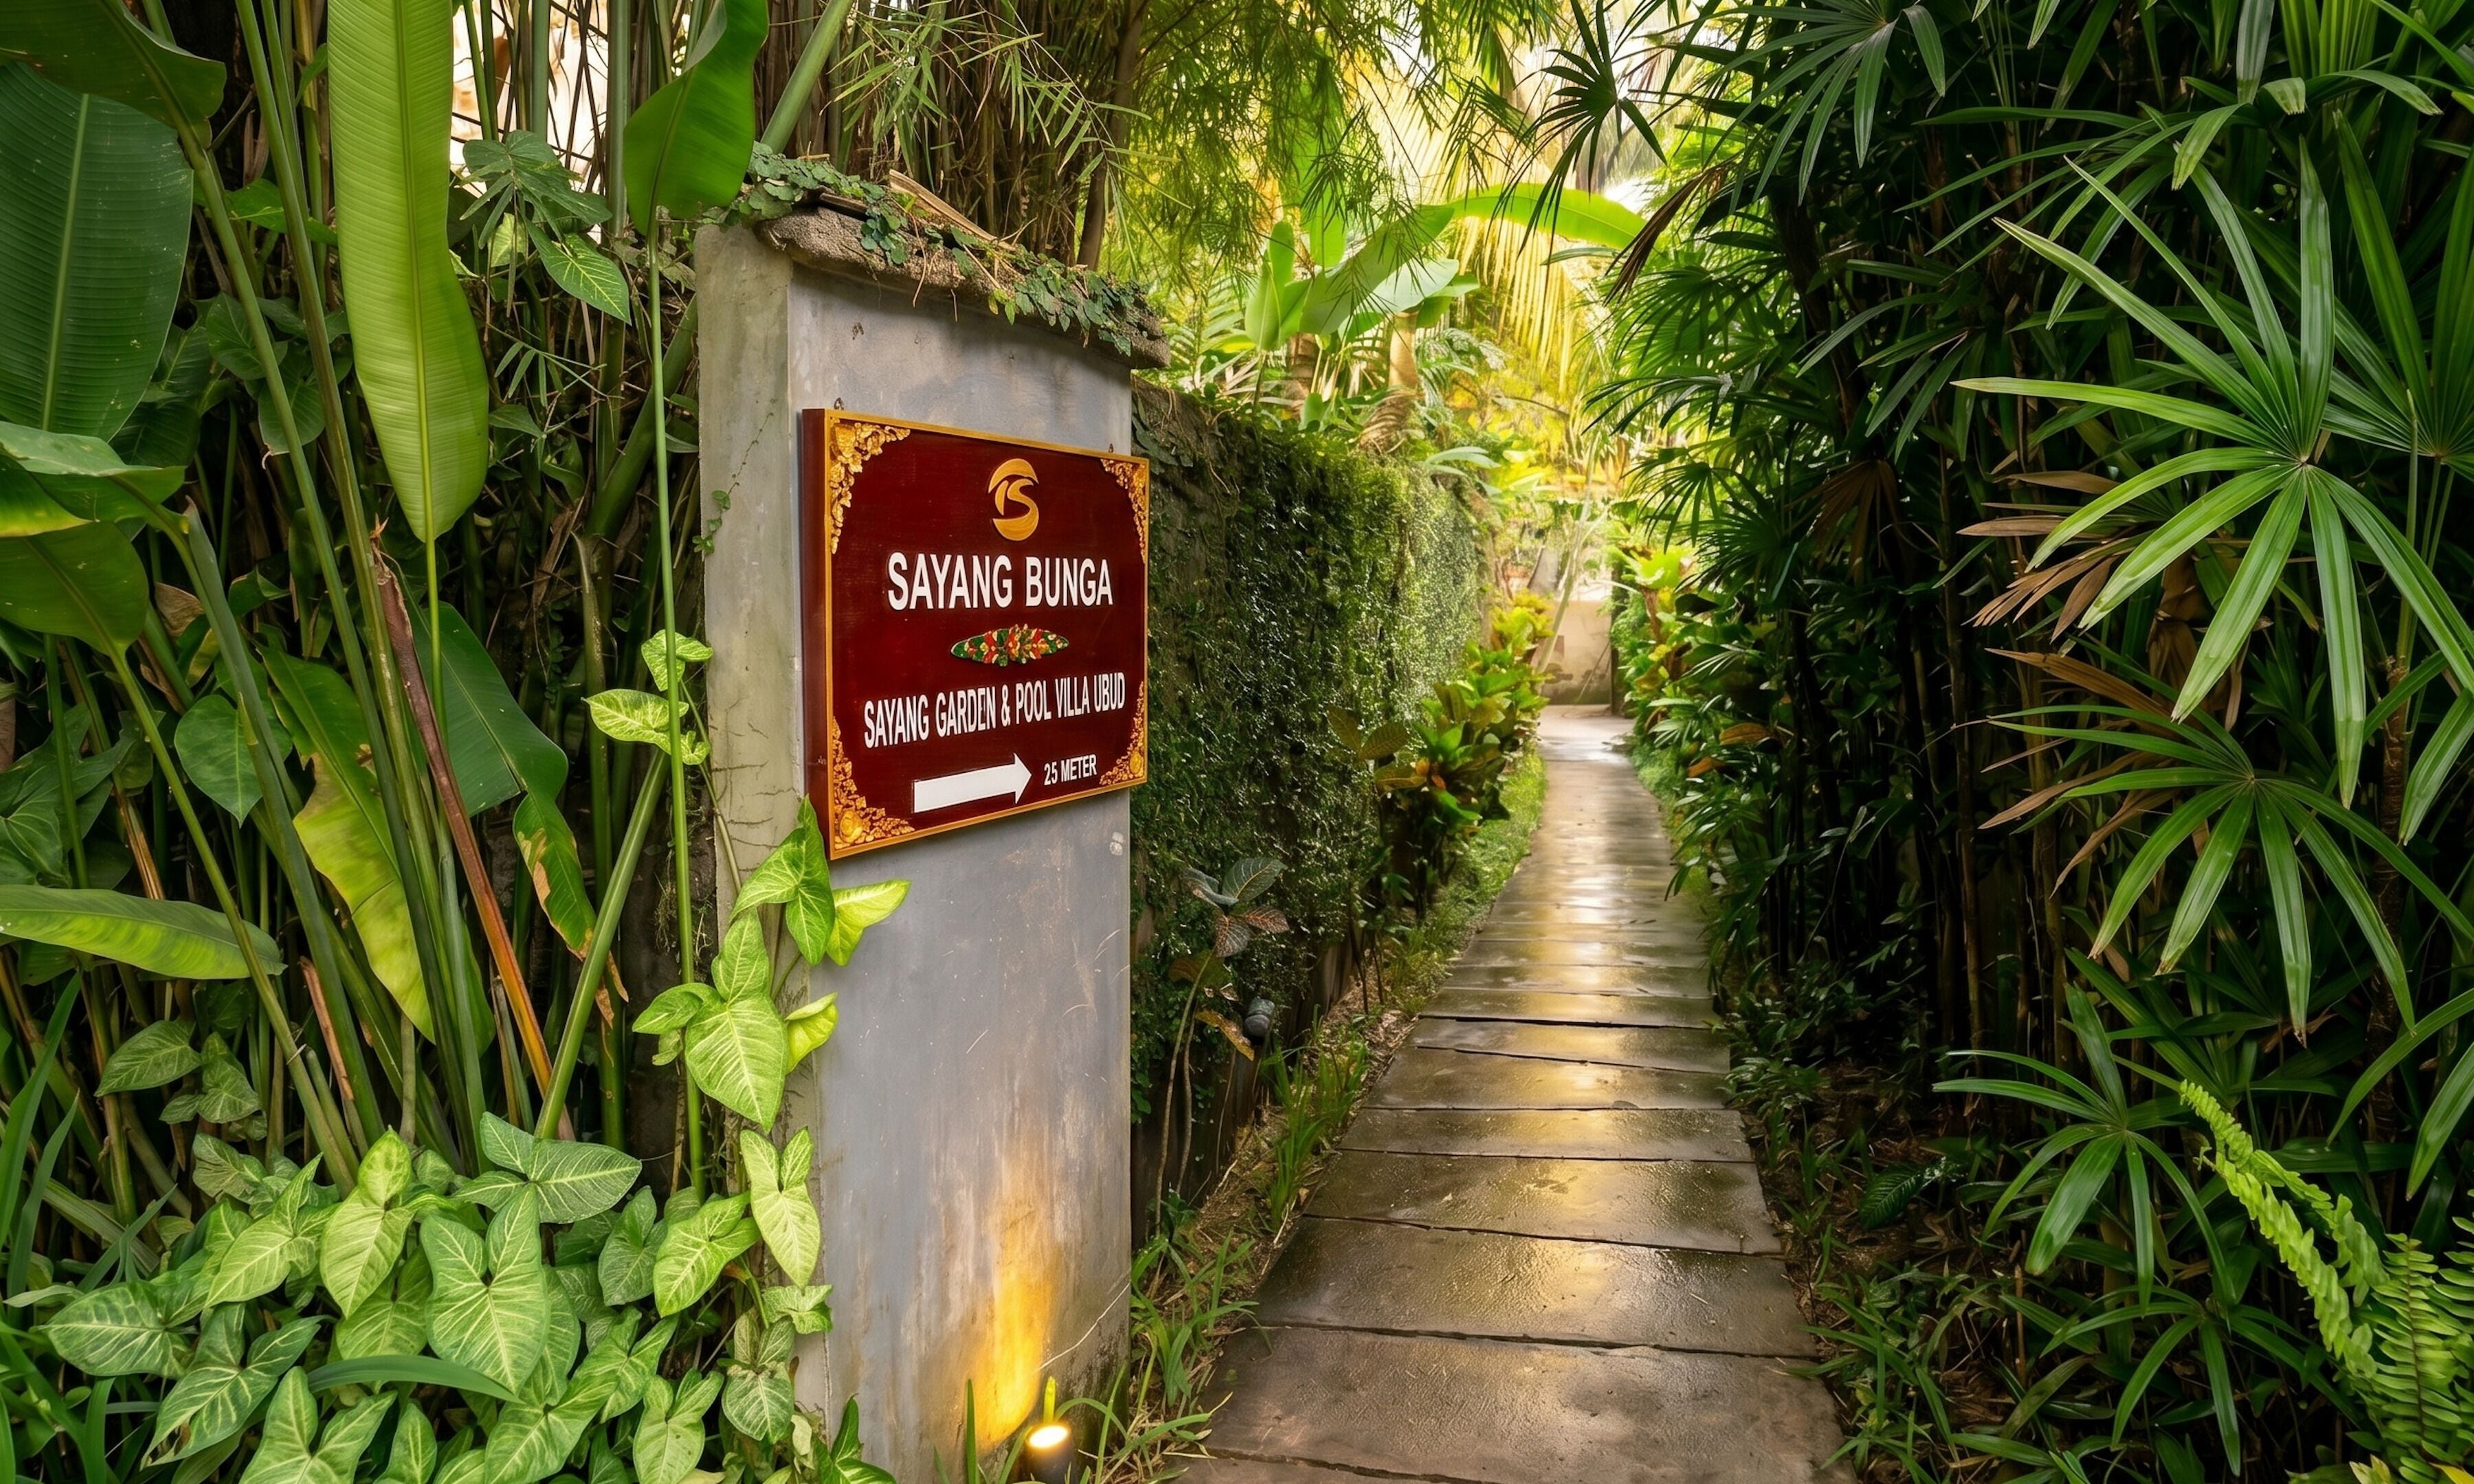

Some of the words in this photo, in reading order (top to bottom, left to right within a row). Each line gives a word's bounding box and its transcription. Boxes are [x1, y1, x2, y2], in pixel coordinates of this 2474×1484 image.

[887, 551, 1014, 611] SAYANG
[1025, 556, 1114, 607] BUNGA
[863, 694, 930, 749] SAYANG
[935, 686, 997, 738] GARDEN
[1001, 684, 1012, 728] &
[1015, 679, 1052, 725] POOL
[1054, 676, 1091, 719] VILLA
[1093, 671, 1126, 713] UBUD
[1043, 761, 1059, 787] 25
[1060, 753, 1098, 783] METER
